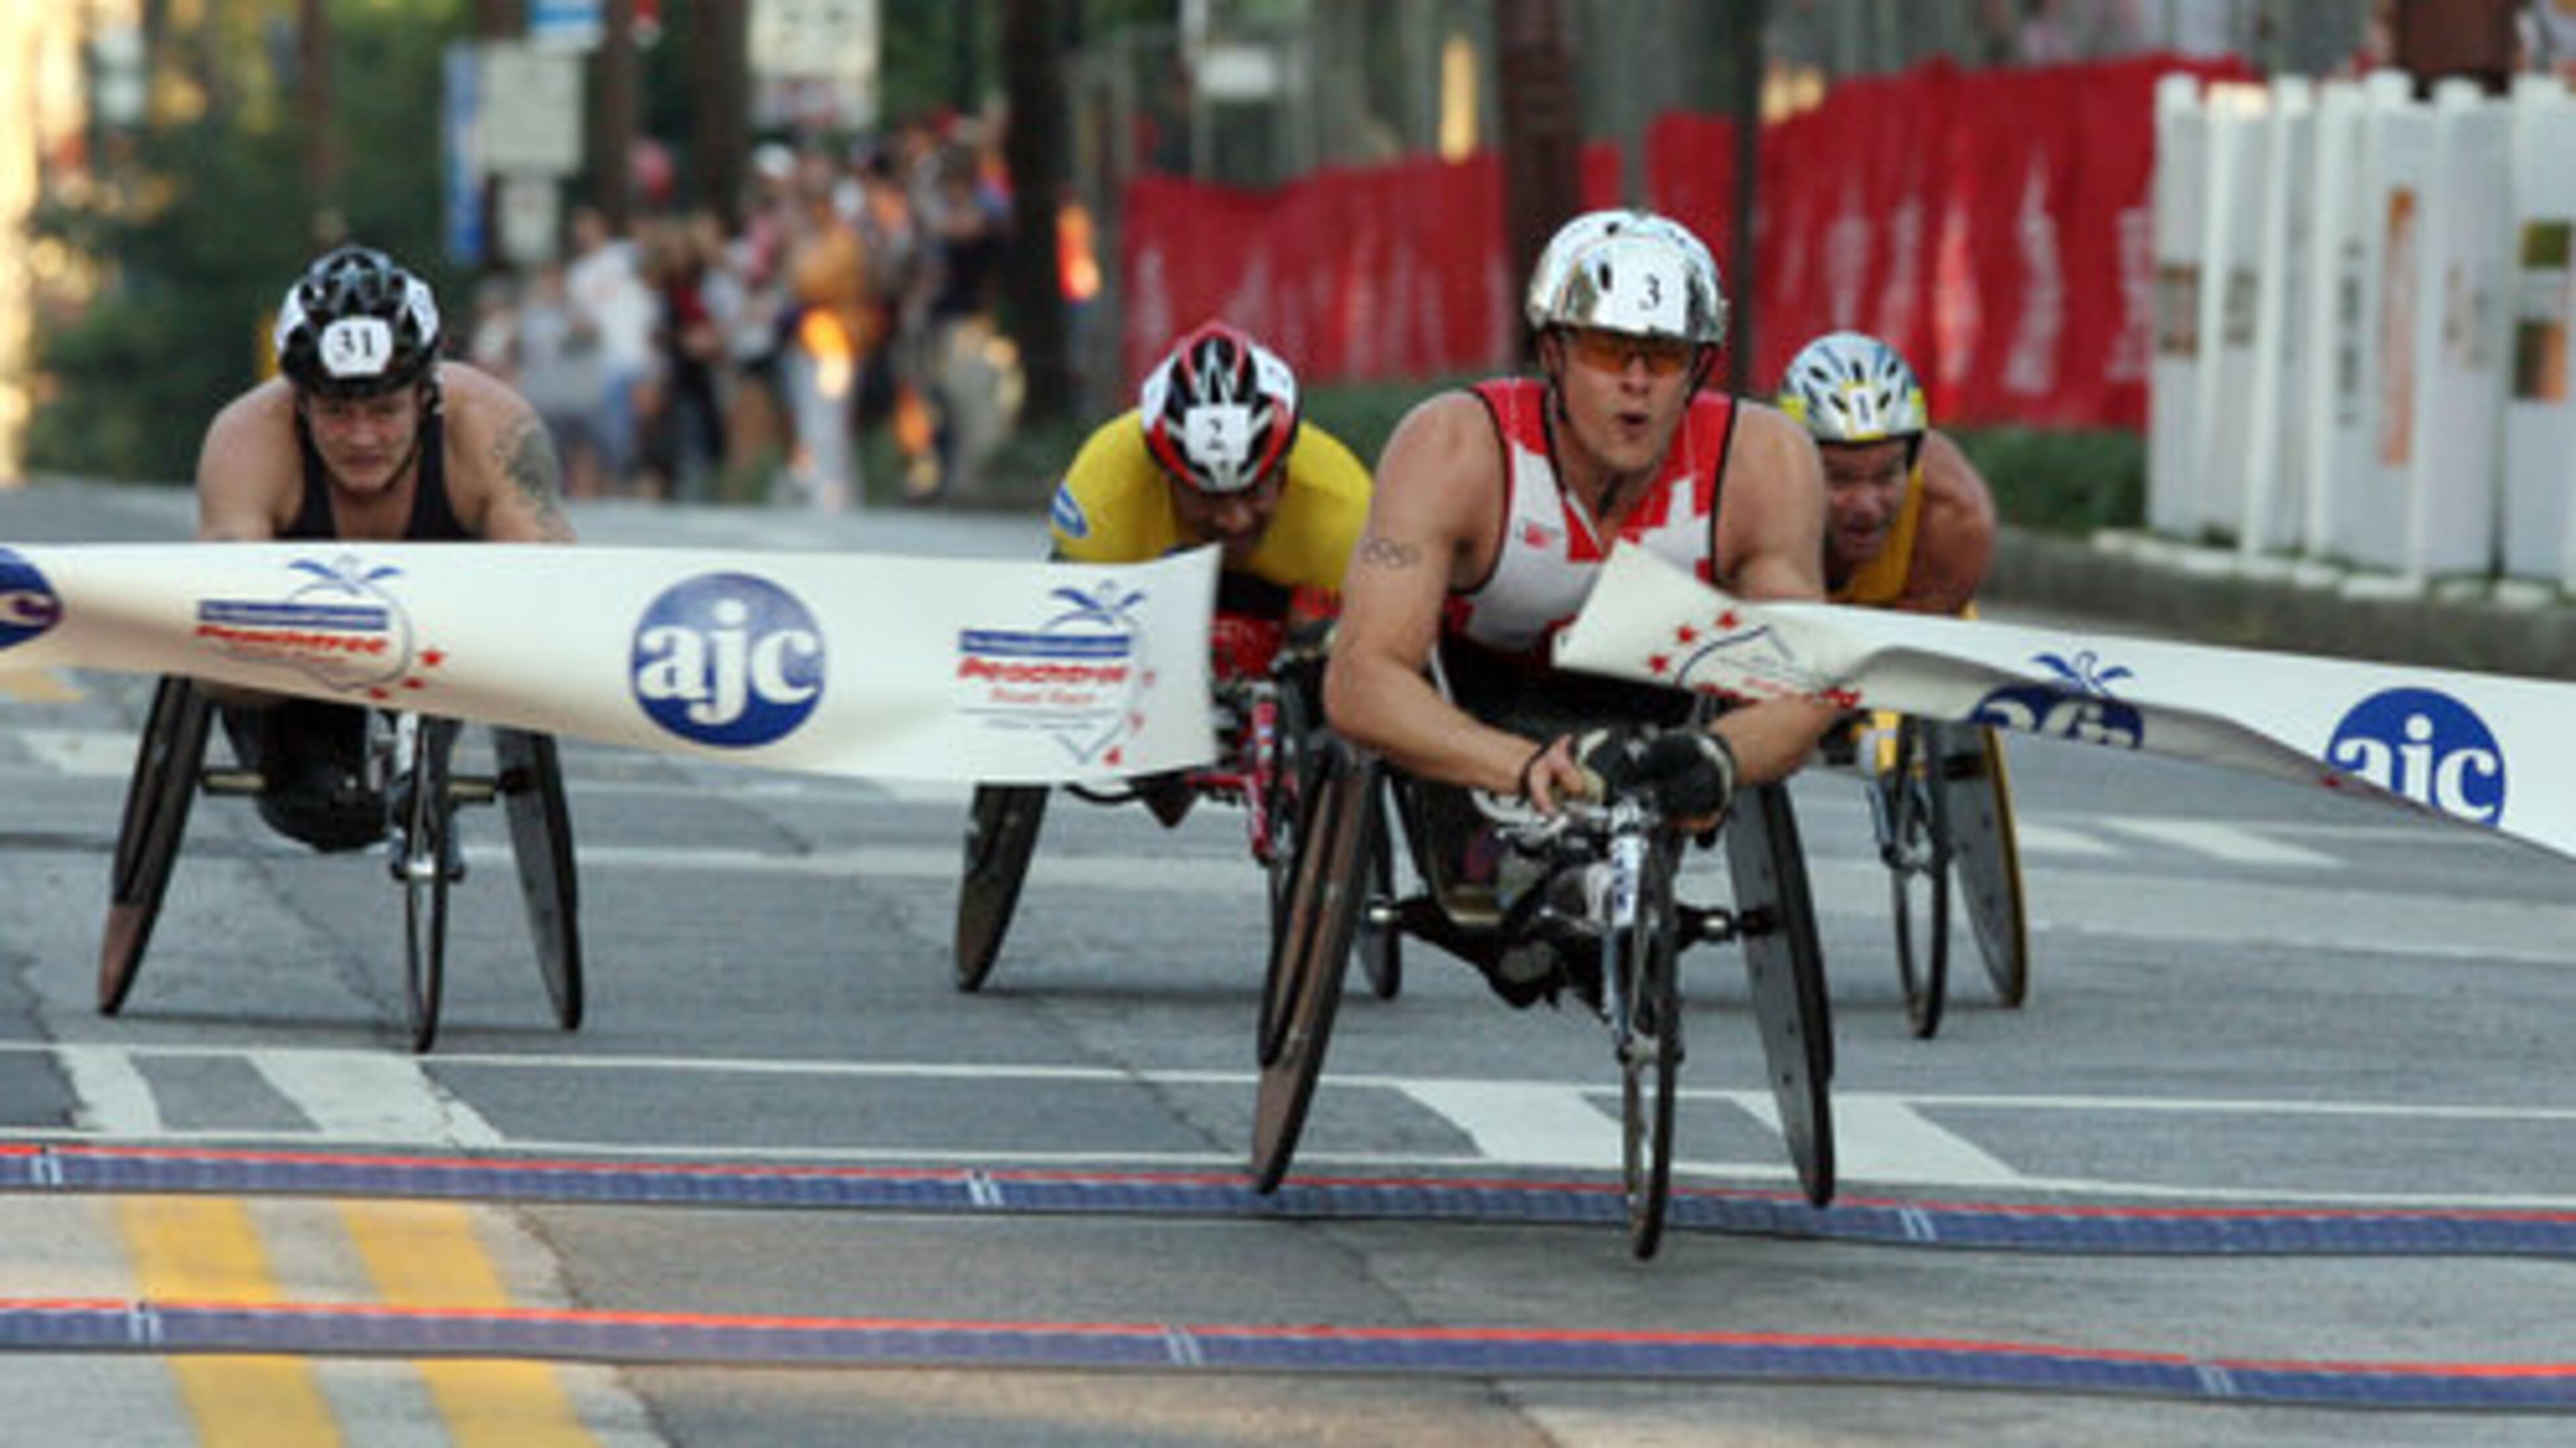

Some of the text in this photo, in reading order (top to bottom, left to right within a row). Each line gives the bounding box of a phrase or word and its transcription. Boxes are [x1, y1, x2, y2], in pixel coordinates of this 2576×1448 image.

[1638, 272, 1661, 311] 3
[336, 327, 374, 363] 31
[1206, 417, 1227, 451] 2
[635, 599, 822, 727] ajc
